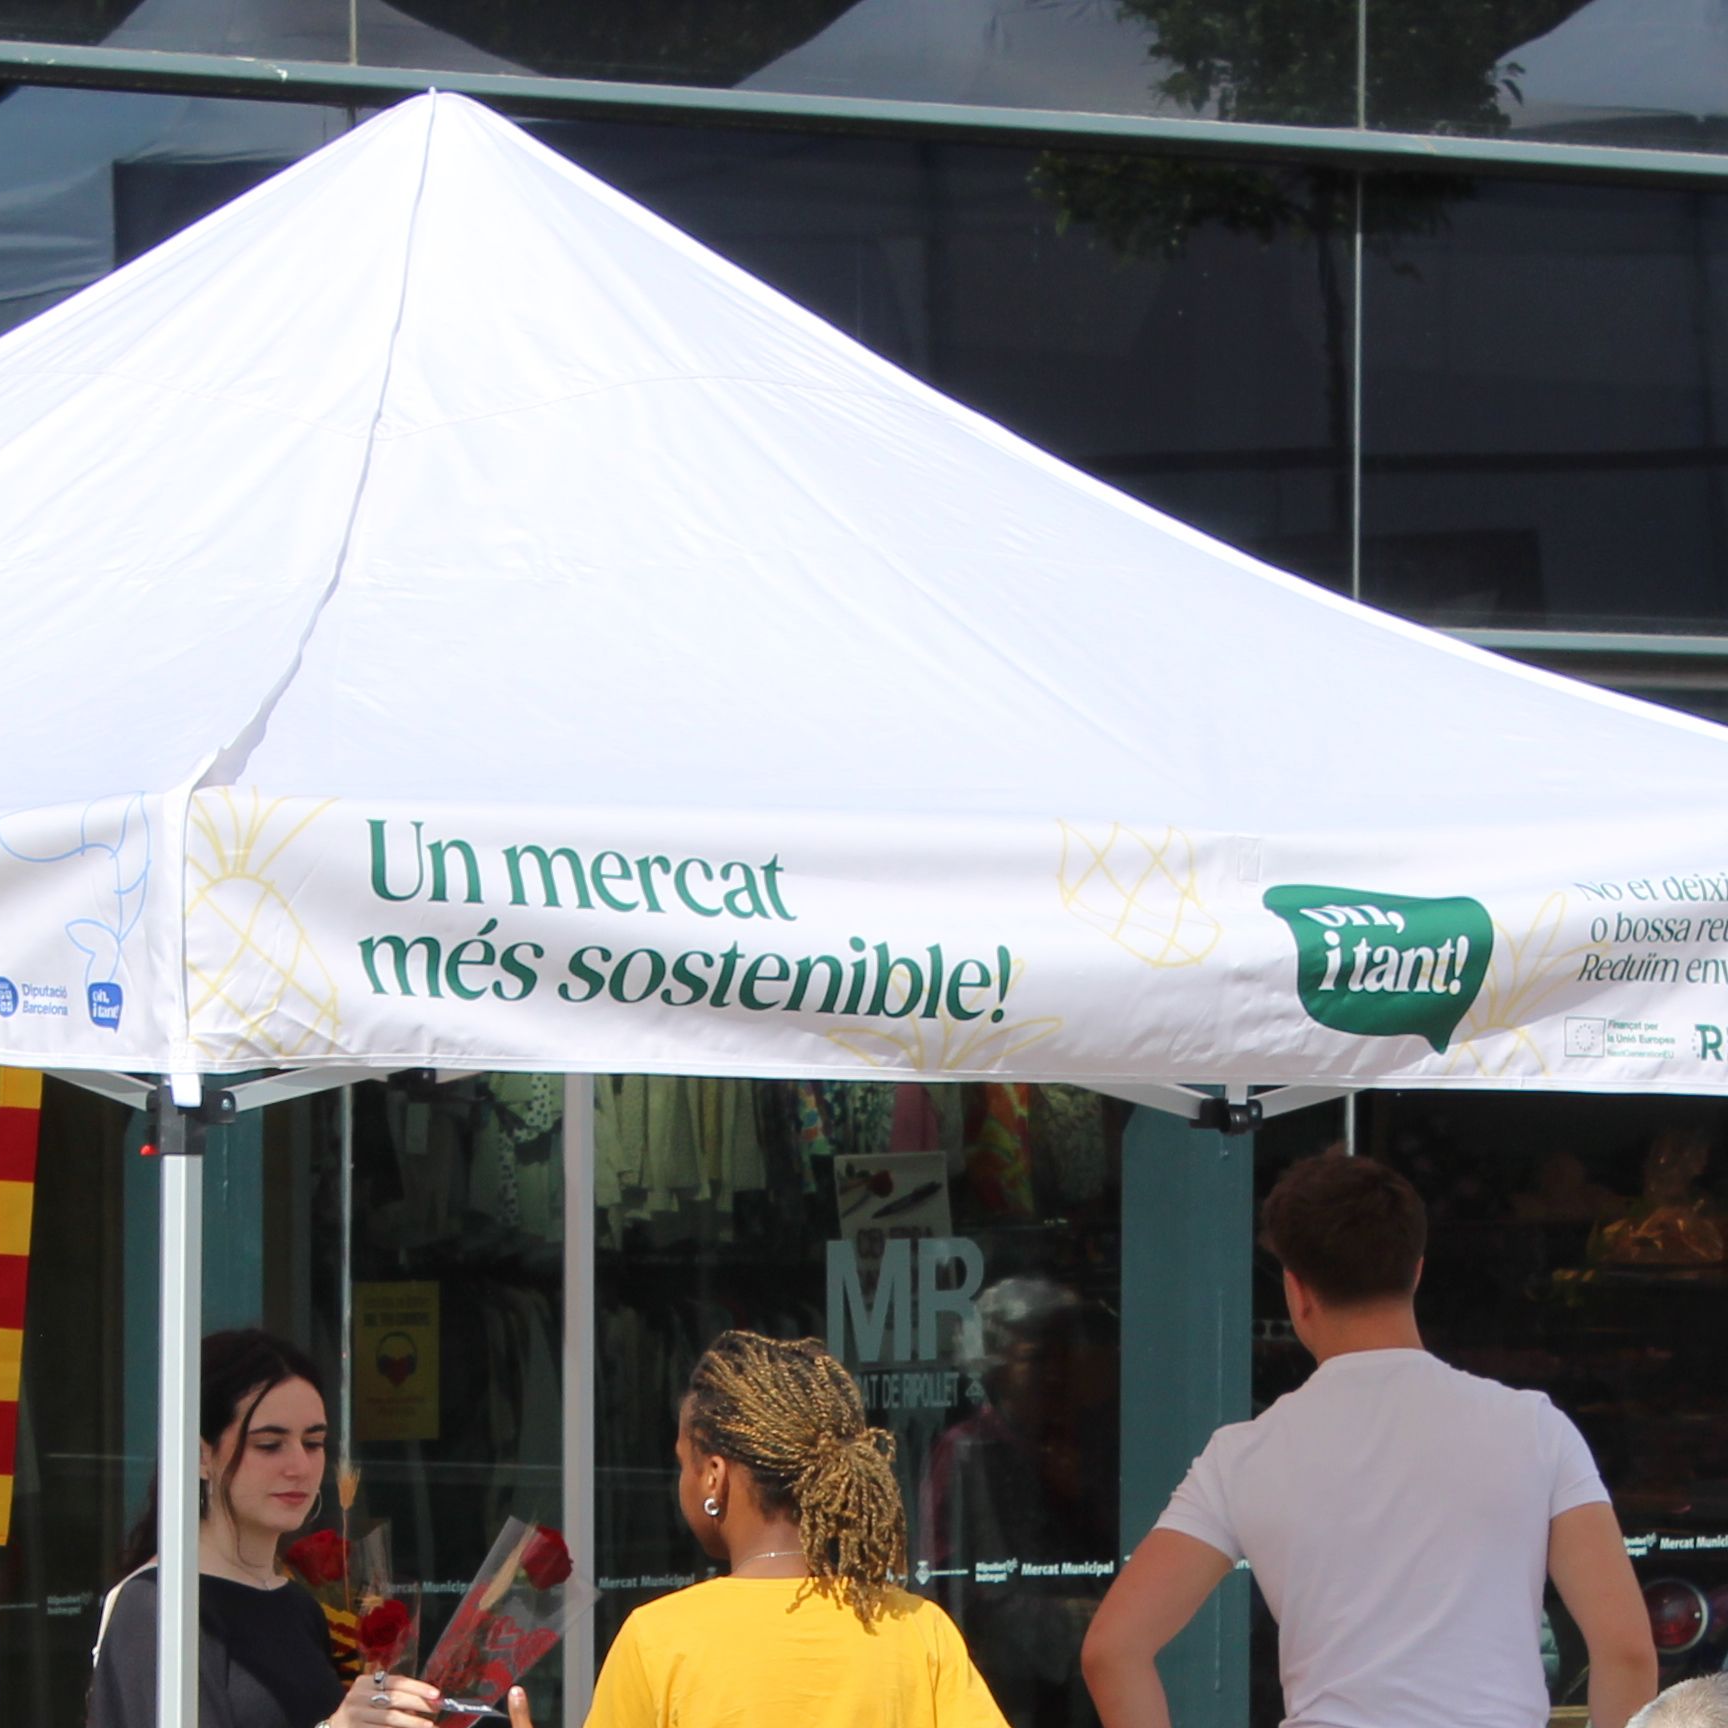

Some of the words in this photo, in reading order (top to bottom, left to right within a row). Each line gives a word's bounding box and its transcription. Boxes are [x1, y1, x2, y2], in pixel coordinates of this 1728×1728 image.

[366, 818, 483, 905] Un
[500, 841, 798, 922] mercat
[1590, 917, 1609, 943] o
[1614, 913, 1691, 943] bossa
[356, 919, 544, 1002] més
[557, 934, 1012, 1024] sostenible!
[1318, 930, 1342, 990] i
[1348, 935, 1469, 995] tant!
[1576, 953, 1680, 983] Reduïm
[826, 1237, 984, 1363] MR
[1660, 1537, 1694, 1549] Mercat
[599, 1577, 639, 1591] Mercat
[642, 1574, 695, 1590] Municipal
[1021, 1563, 1060, 1576] Mercat
[1061, 1561, 1114, 1577] Municipal
